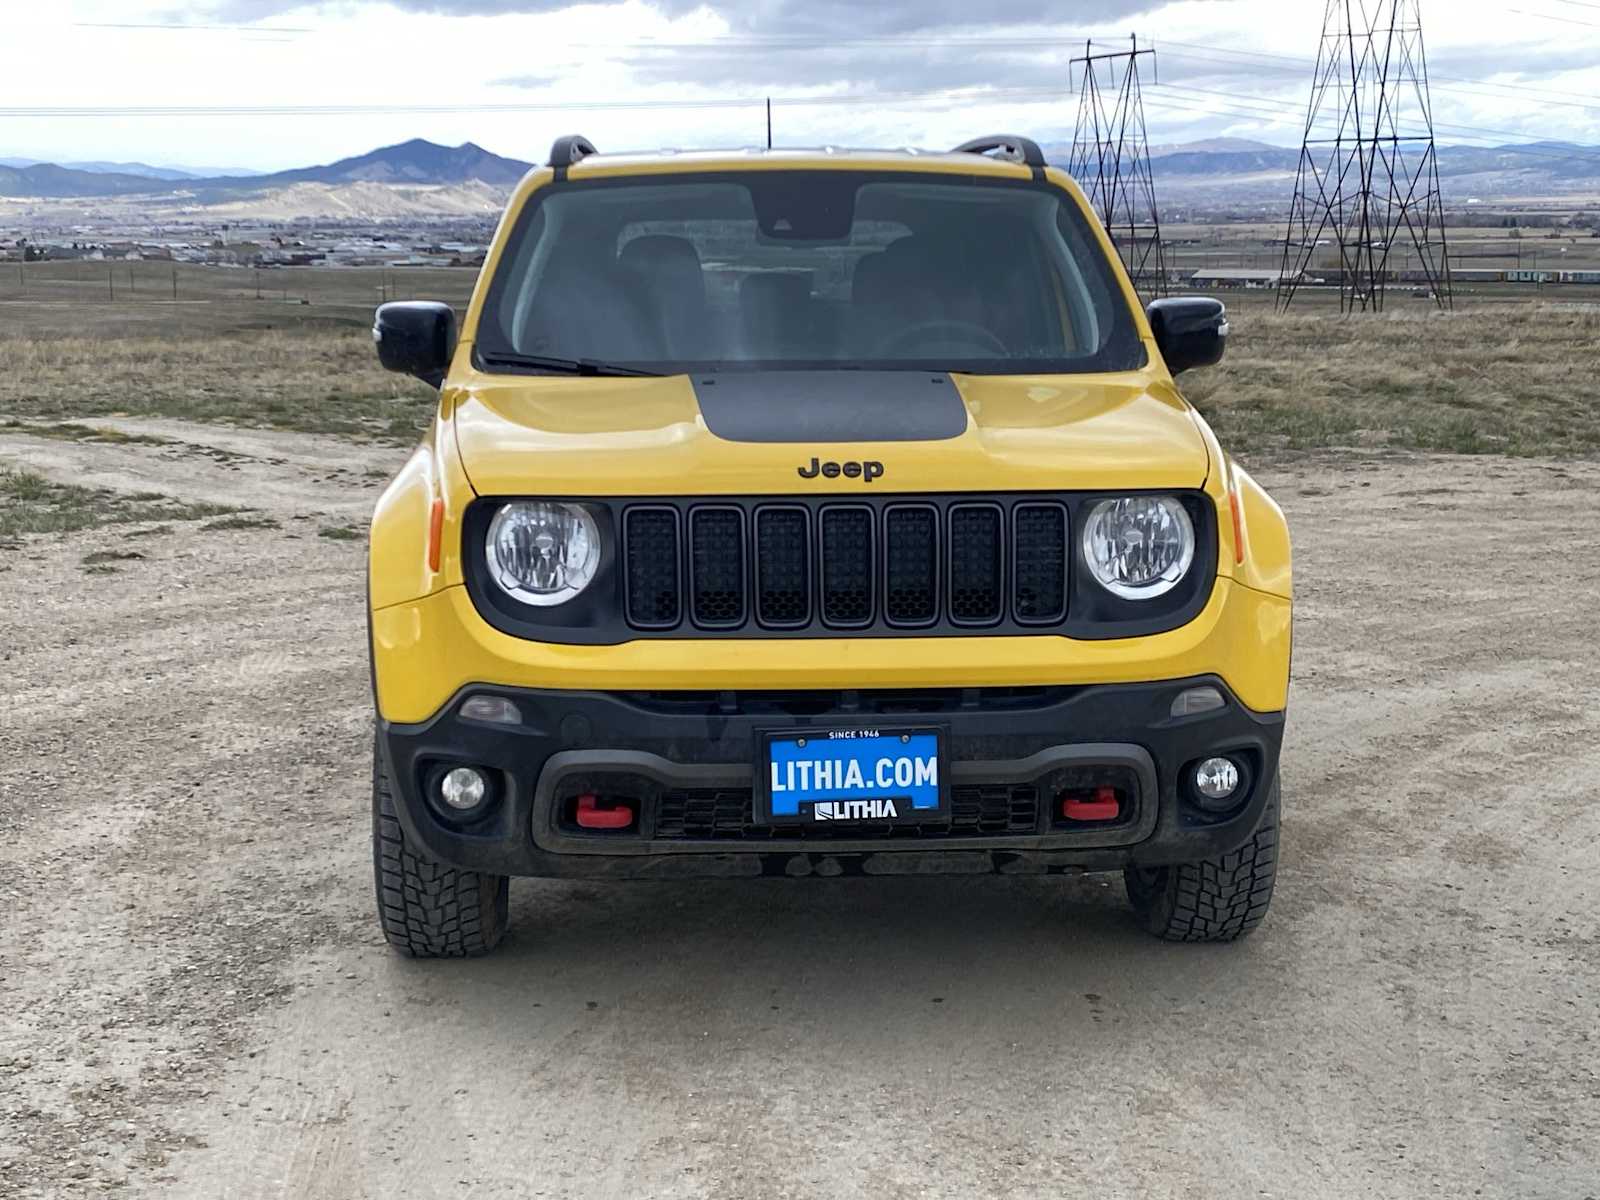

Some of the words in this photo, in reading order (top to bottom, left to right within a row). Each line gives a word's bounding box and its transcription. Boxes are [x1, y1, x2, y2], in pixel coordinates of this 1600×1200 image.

[798, 457, 884, 482] Jeep
[829, 731, 857, 739] SINCE
[859, 730, 880, 738] 1946
[771, 757, 938, 791] LITHIA.COM
[833, 799, 898, 820] LITHIA
